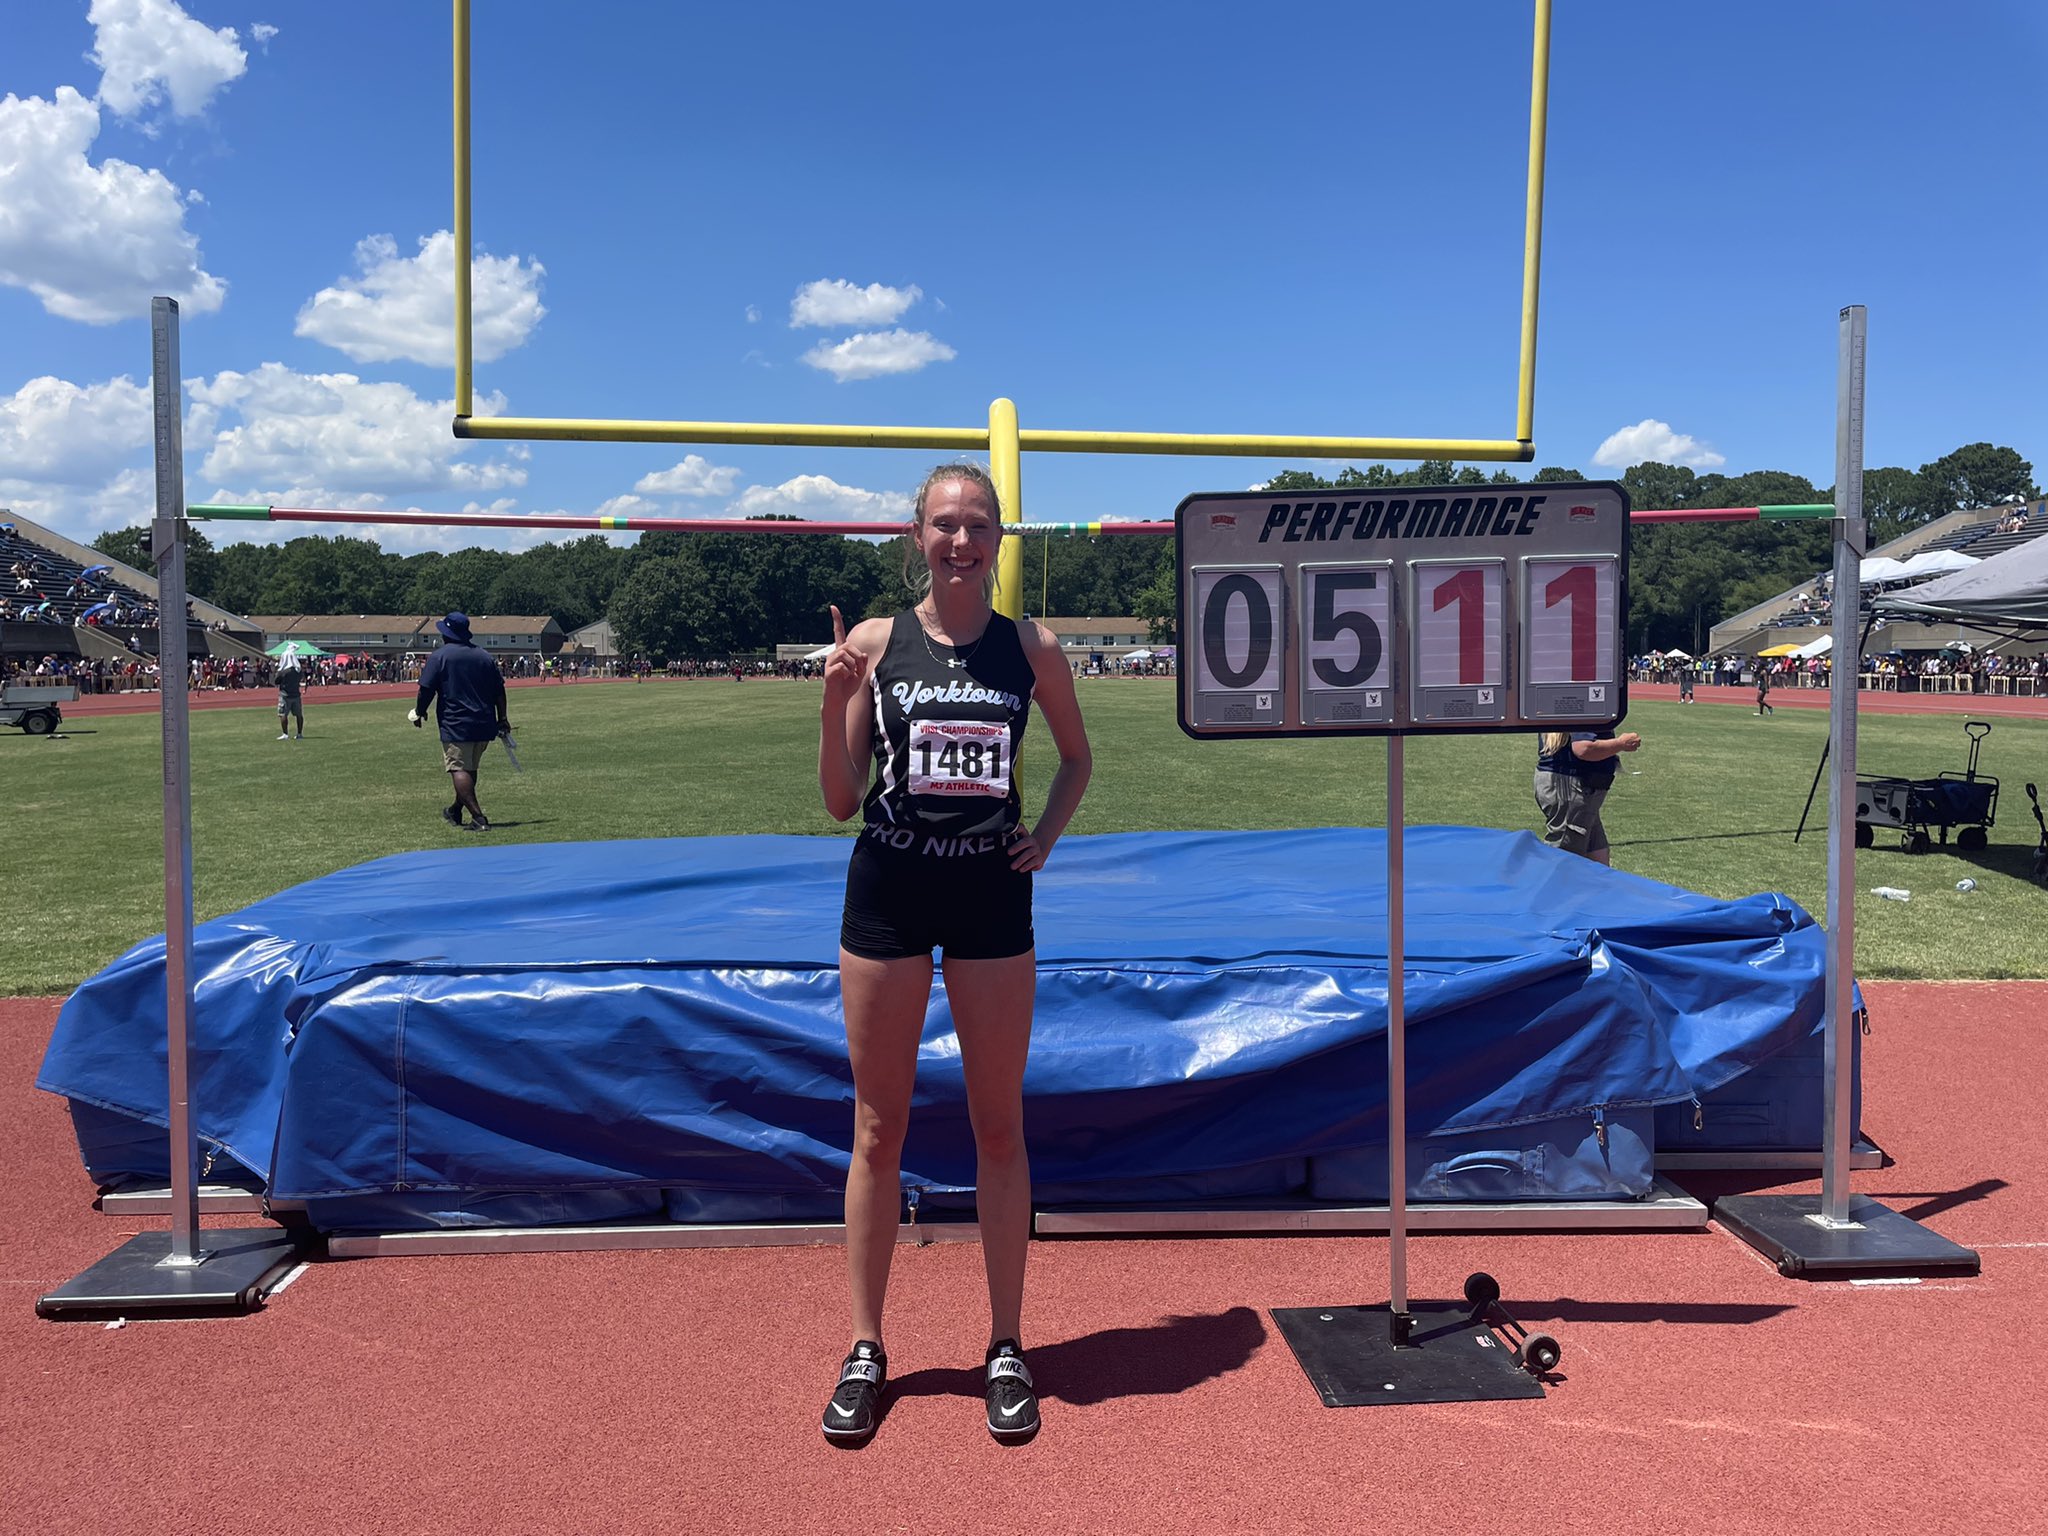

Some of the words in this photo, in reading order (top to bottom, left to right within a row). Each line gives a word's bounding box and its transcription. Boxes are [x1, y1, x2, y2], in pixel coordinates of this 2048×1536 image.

[1258, 496, 1547, 543] PERFORMANCE
[892, 680, 1022, 715] Yorktown
[941, 725, 1003, 736] CHAMPIONSHIPS
[916, 740, 1001, 779] 1481
[945, 782, 990, 792] ATHLETIC
[922, 835, 995, 857] NIKE
[844, 1363, 873, 1377] NIKE
[997, 1360, 1023, 1374] NIKE
